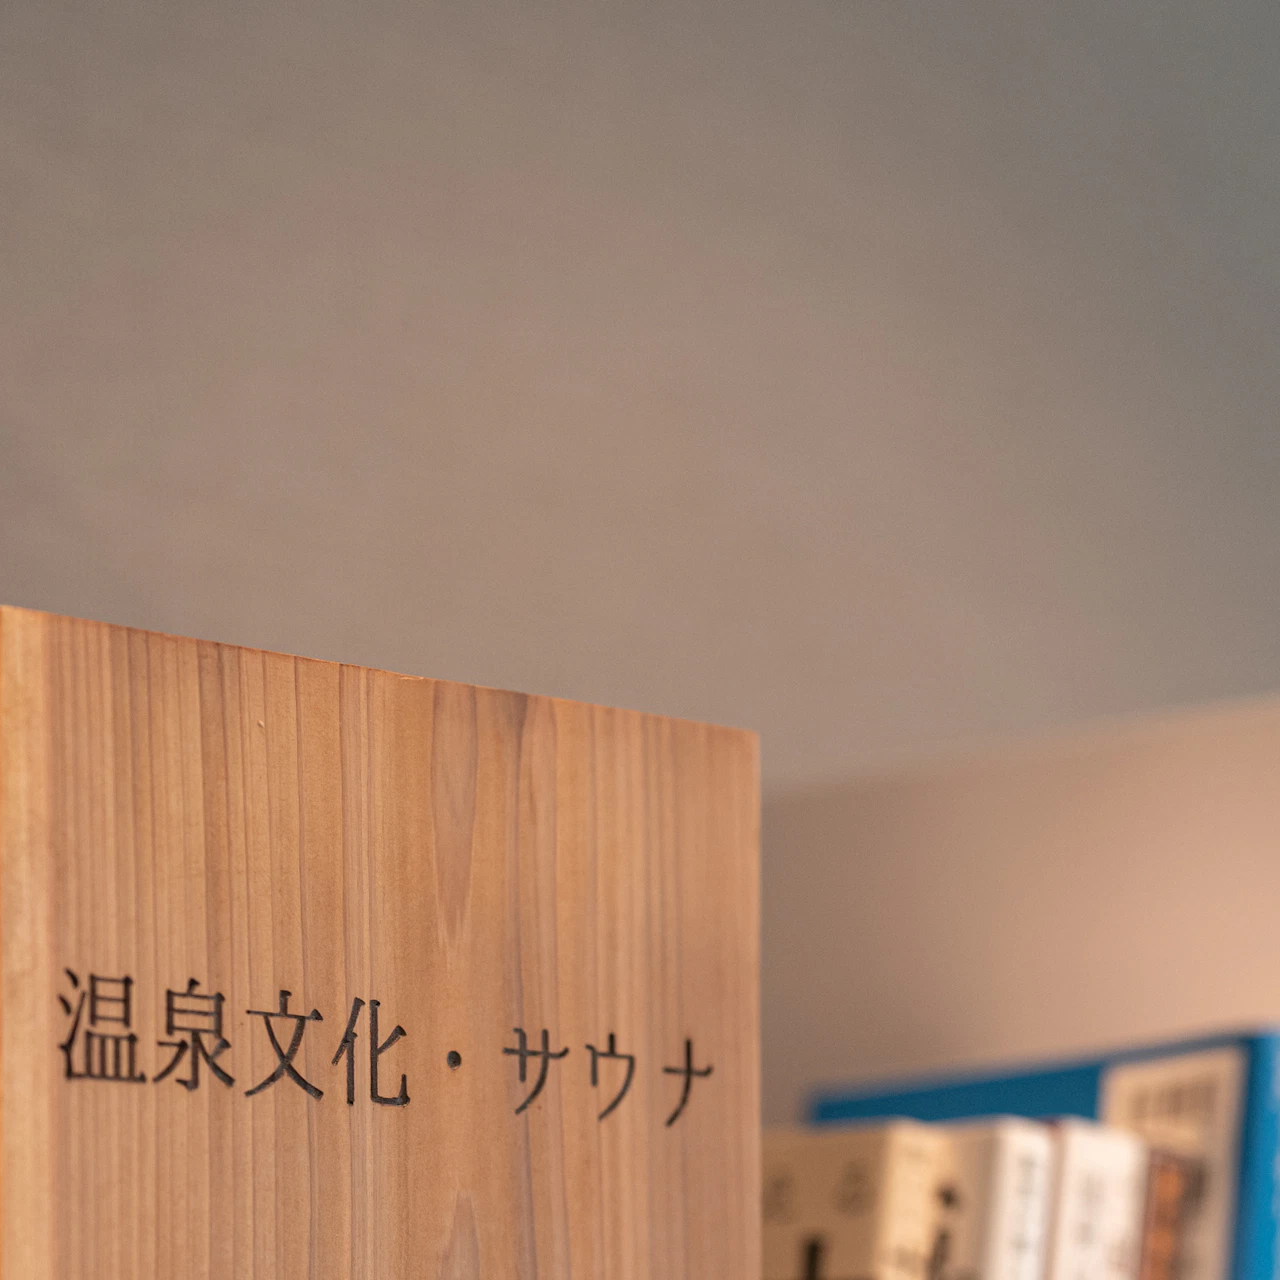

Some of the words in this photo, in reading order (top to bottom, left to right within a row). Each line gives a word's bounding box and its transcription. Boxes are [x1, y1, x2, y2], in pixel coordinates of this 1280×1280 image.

[56, 966, 714, 1128] 温泉文化・サウナ
